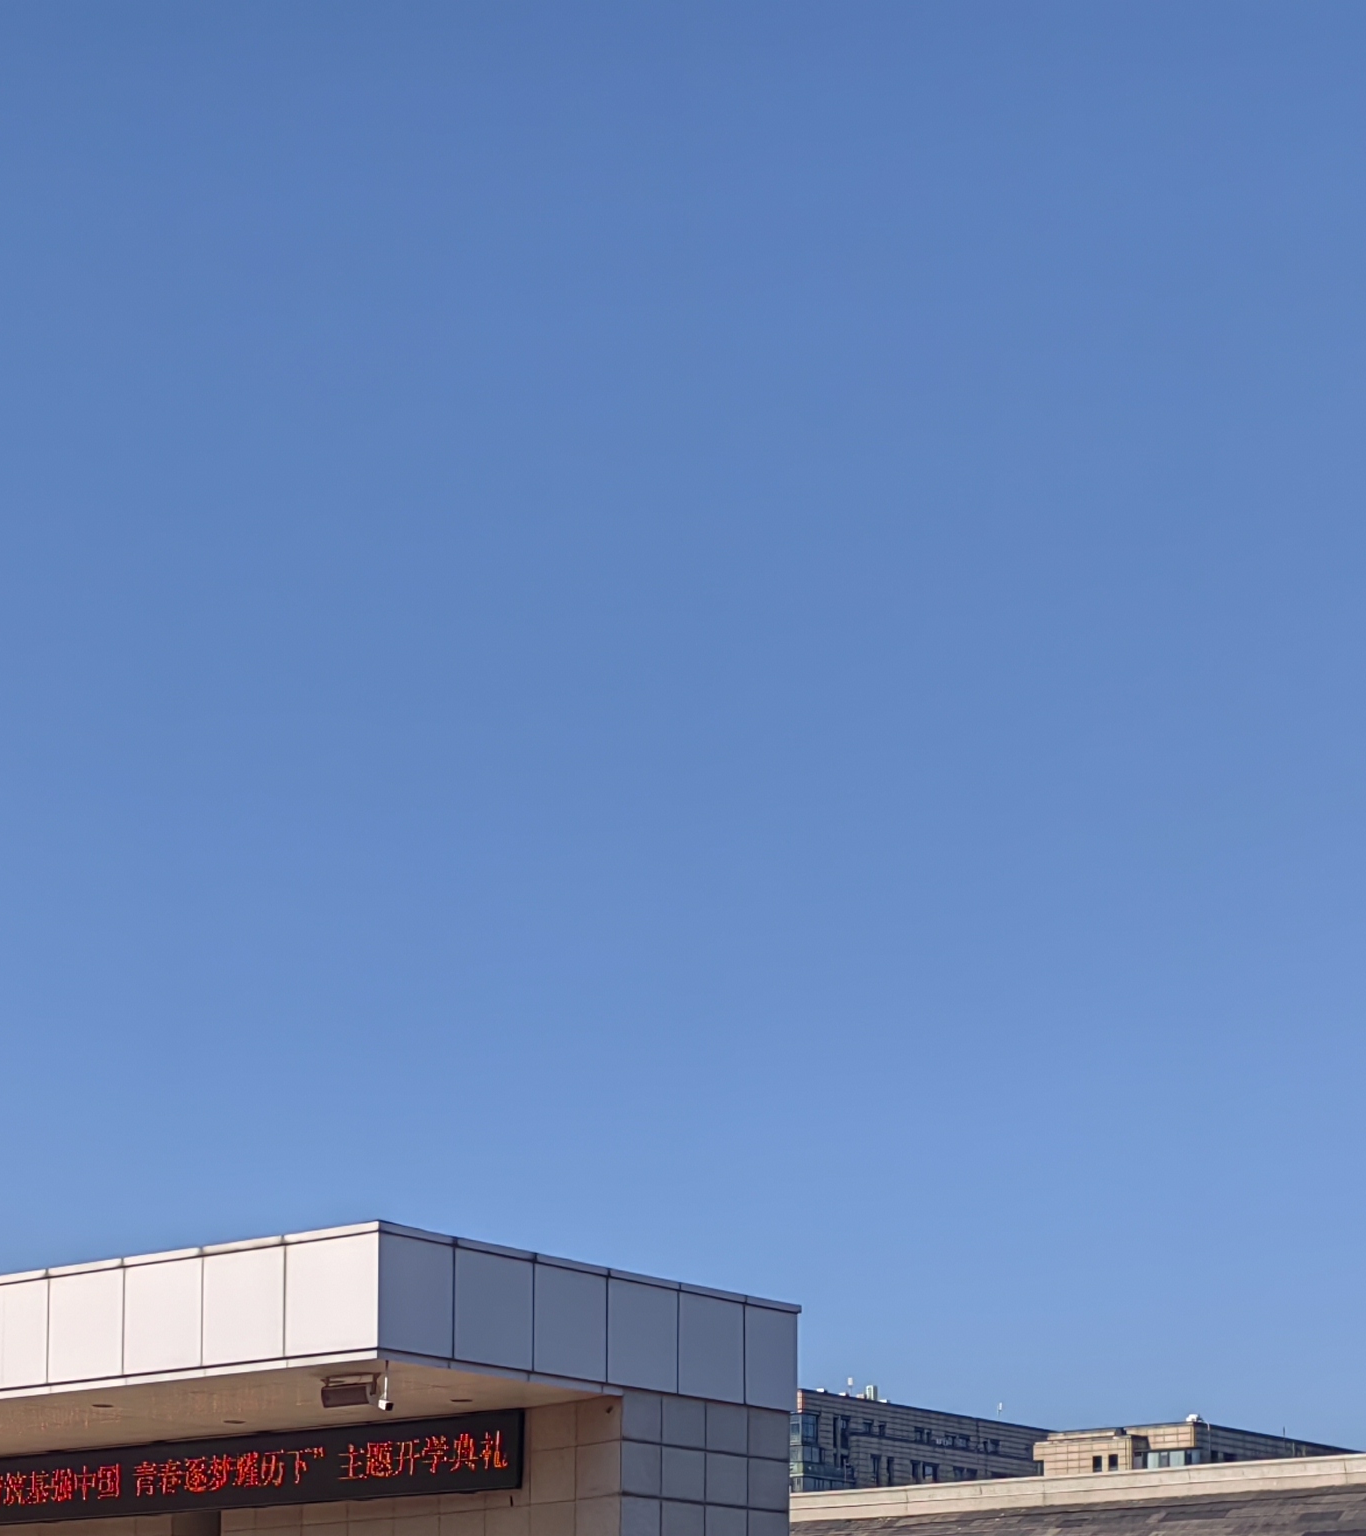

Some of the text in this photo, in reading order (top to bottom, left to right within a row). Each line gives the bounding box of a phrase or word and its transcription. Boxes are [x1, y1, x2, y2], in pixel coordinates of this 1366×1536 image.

[338, 1430, 508, 1480] 主题开学典礼
